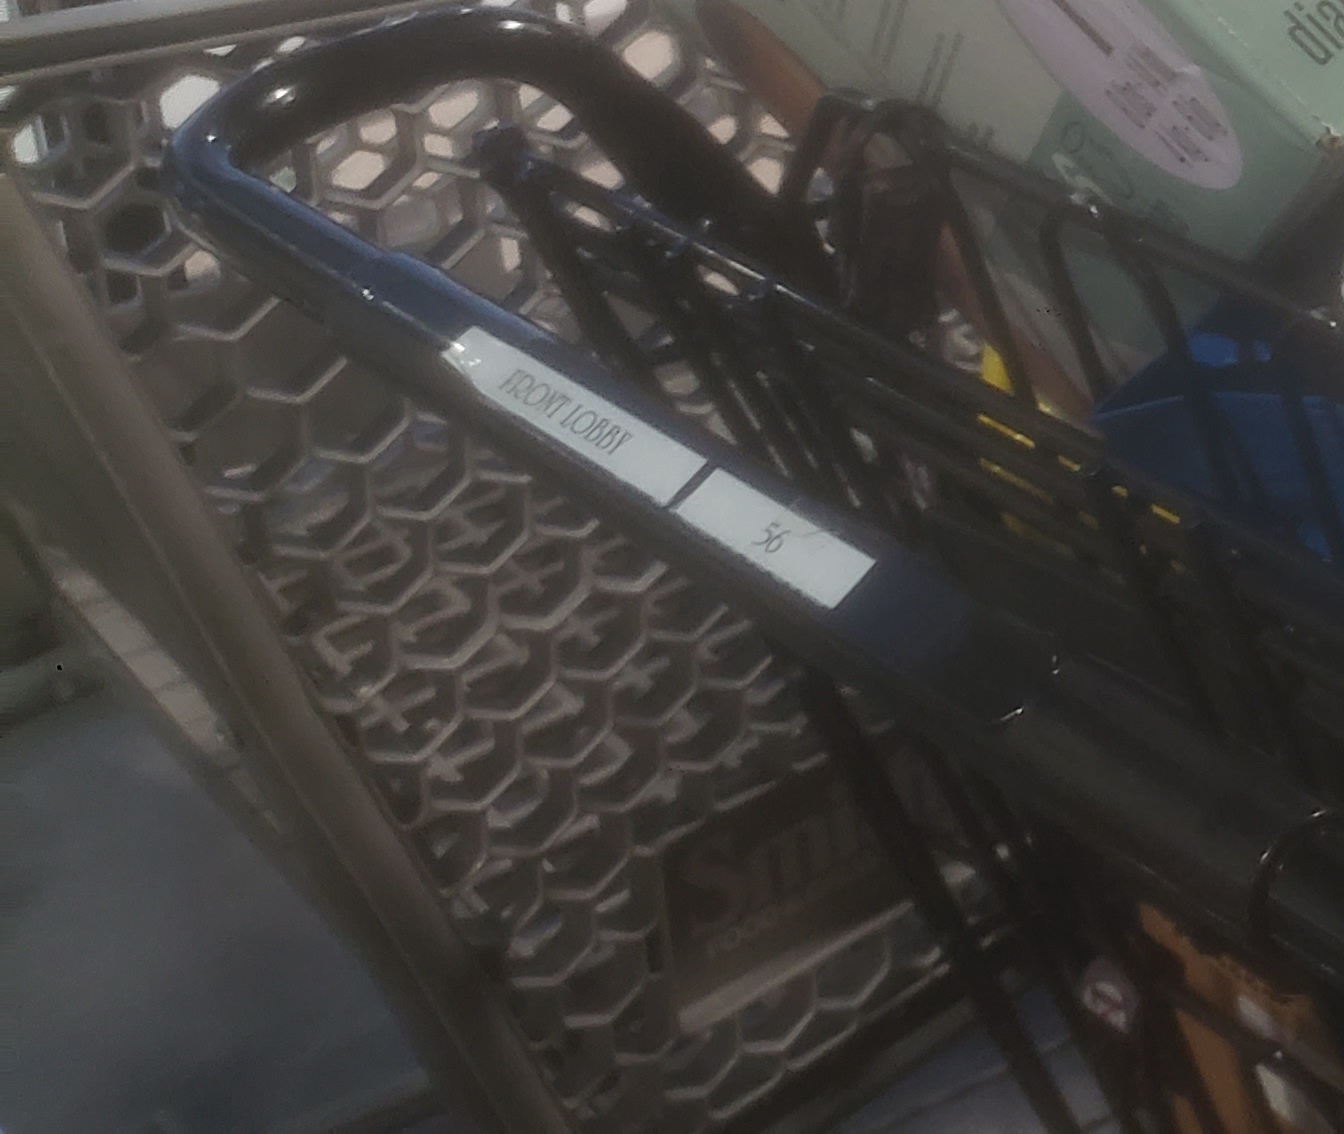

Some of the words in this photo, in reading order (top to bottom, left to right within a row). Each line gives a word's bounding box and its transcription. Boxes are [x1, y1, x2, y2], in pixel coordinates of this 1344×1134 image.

[498, 368, 572, 419] FRONT
[560, 403, 634, 456] LOBBY
[752, 521, 791, 554] 56
